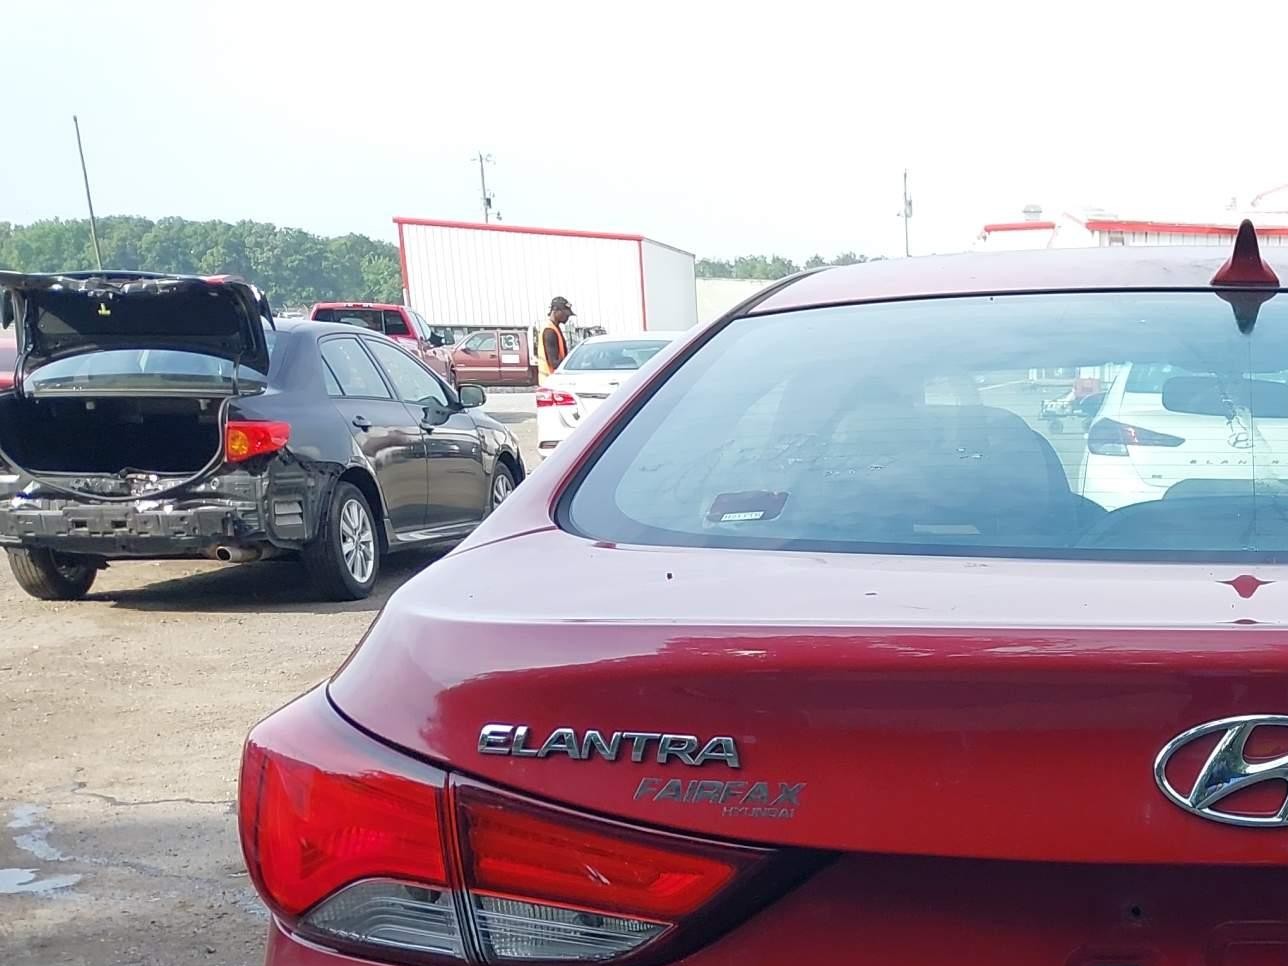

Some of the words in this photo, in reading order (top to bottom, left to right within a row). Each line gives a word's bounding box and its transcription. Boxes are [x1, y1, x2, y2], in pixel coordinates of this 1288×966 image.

[477, 723, 741, 768] ELANTRA
[633, 777, 807, 806] FAIRFAX
[721, 806, 795, 818] HYUNDAI
